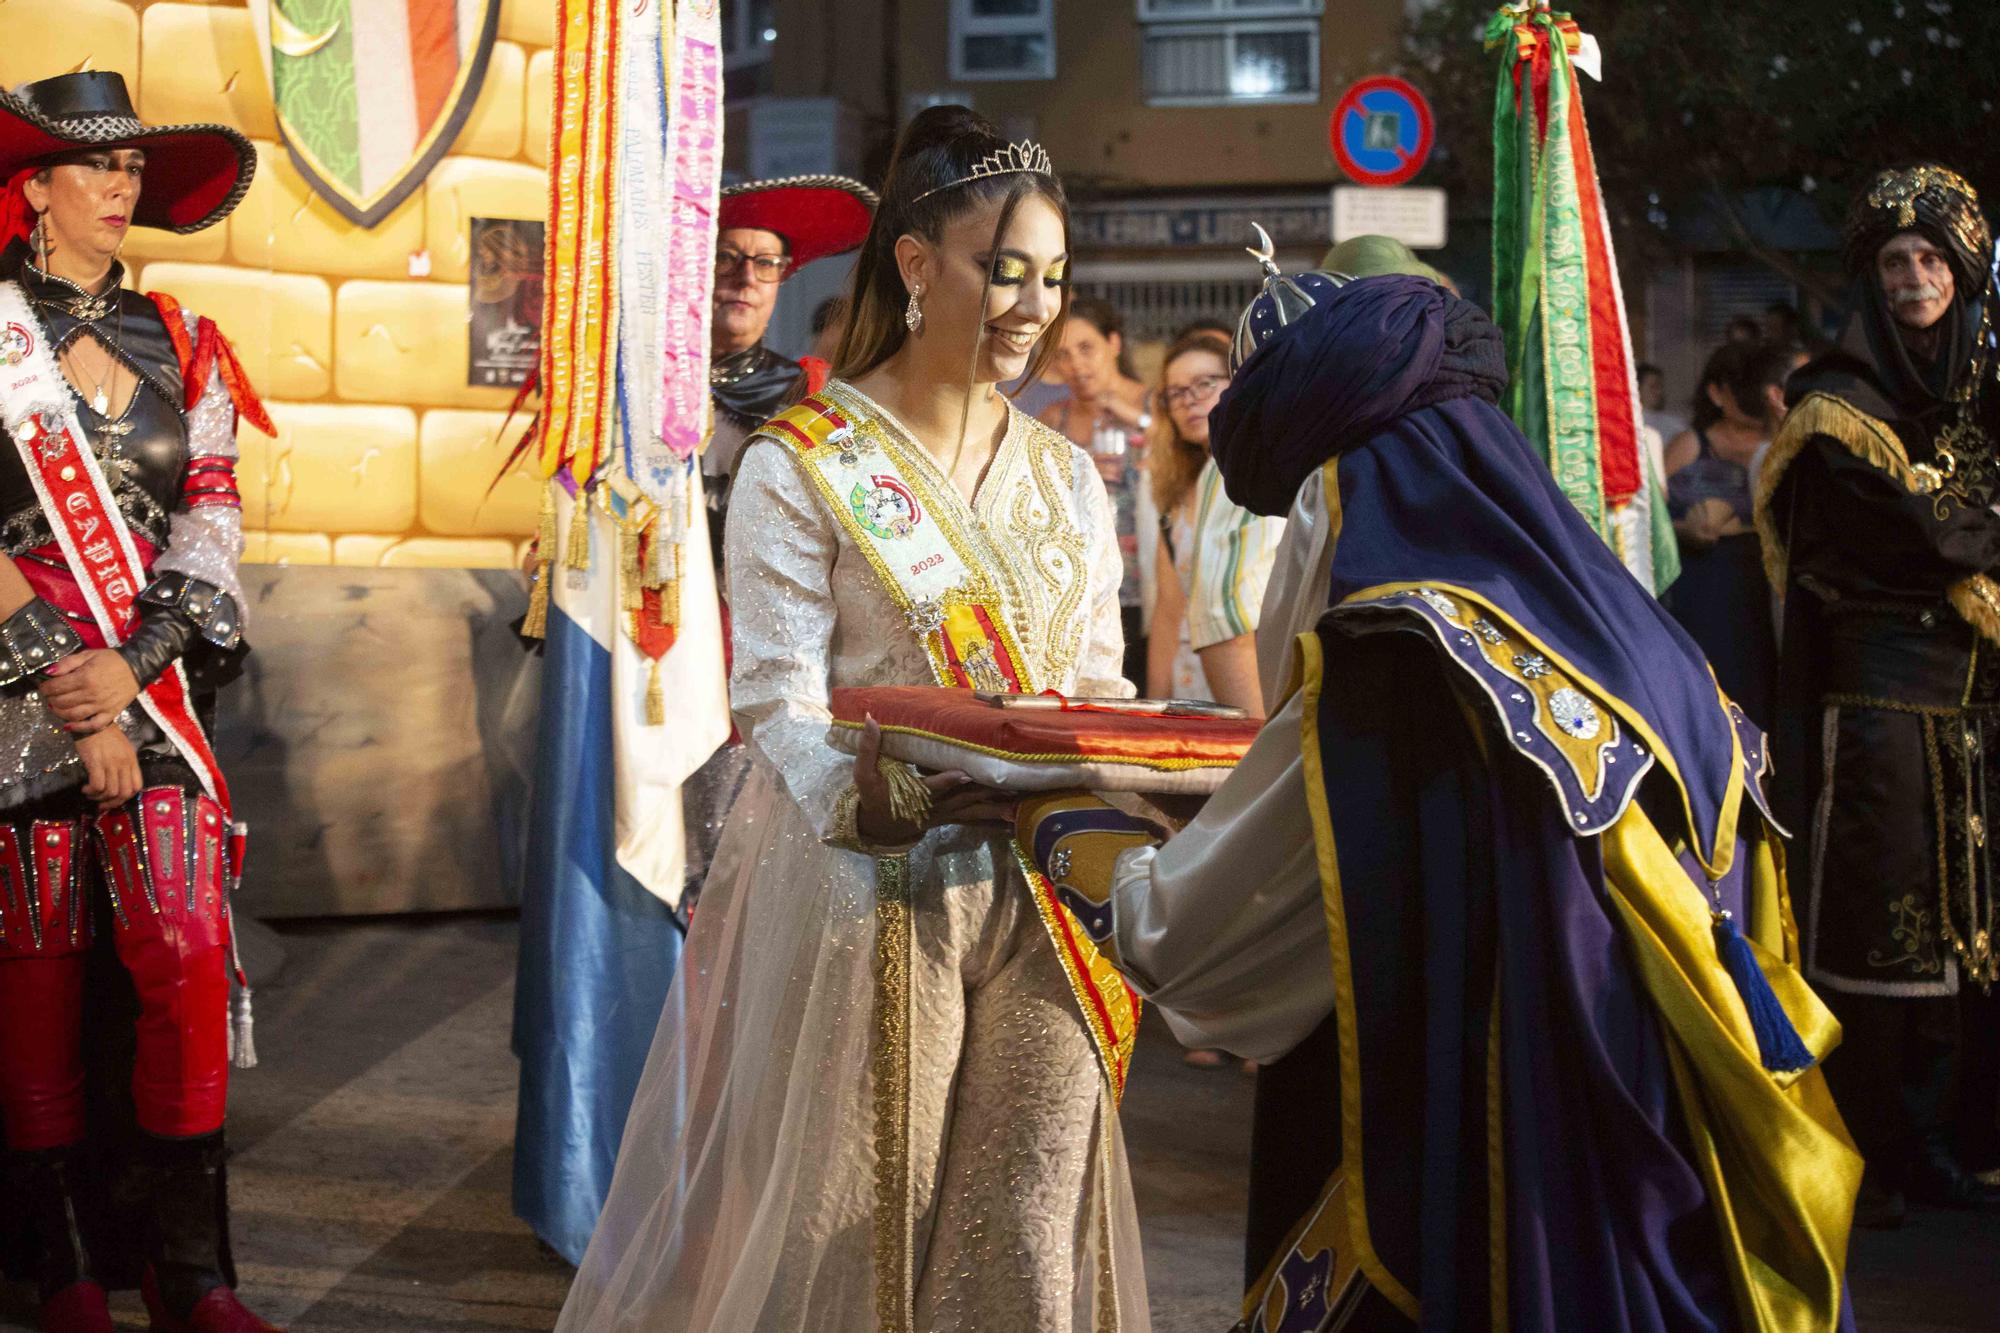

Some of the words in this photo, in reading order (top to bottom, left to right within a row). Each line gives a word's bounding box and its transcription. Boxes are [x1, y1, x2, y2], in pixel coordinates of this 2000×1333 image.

[626, 129, 649, 230] PALOMARES
[11, 374, 39, 391] 2022
[65, 491, 136, 634] CAPITA
[911, 553, 943, 575] 2022
